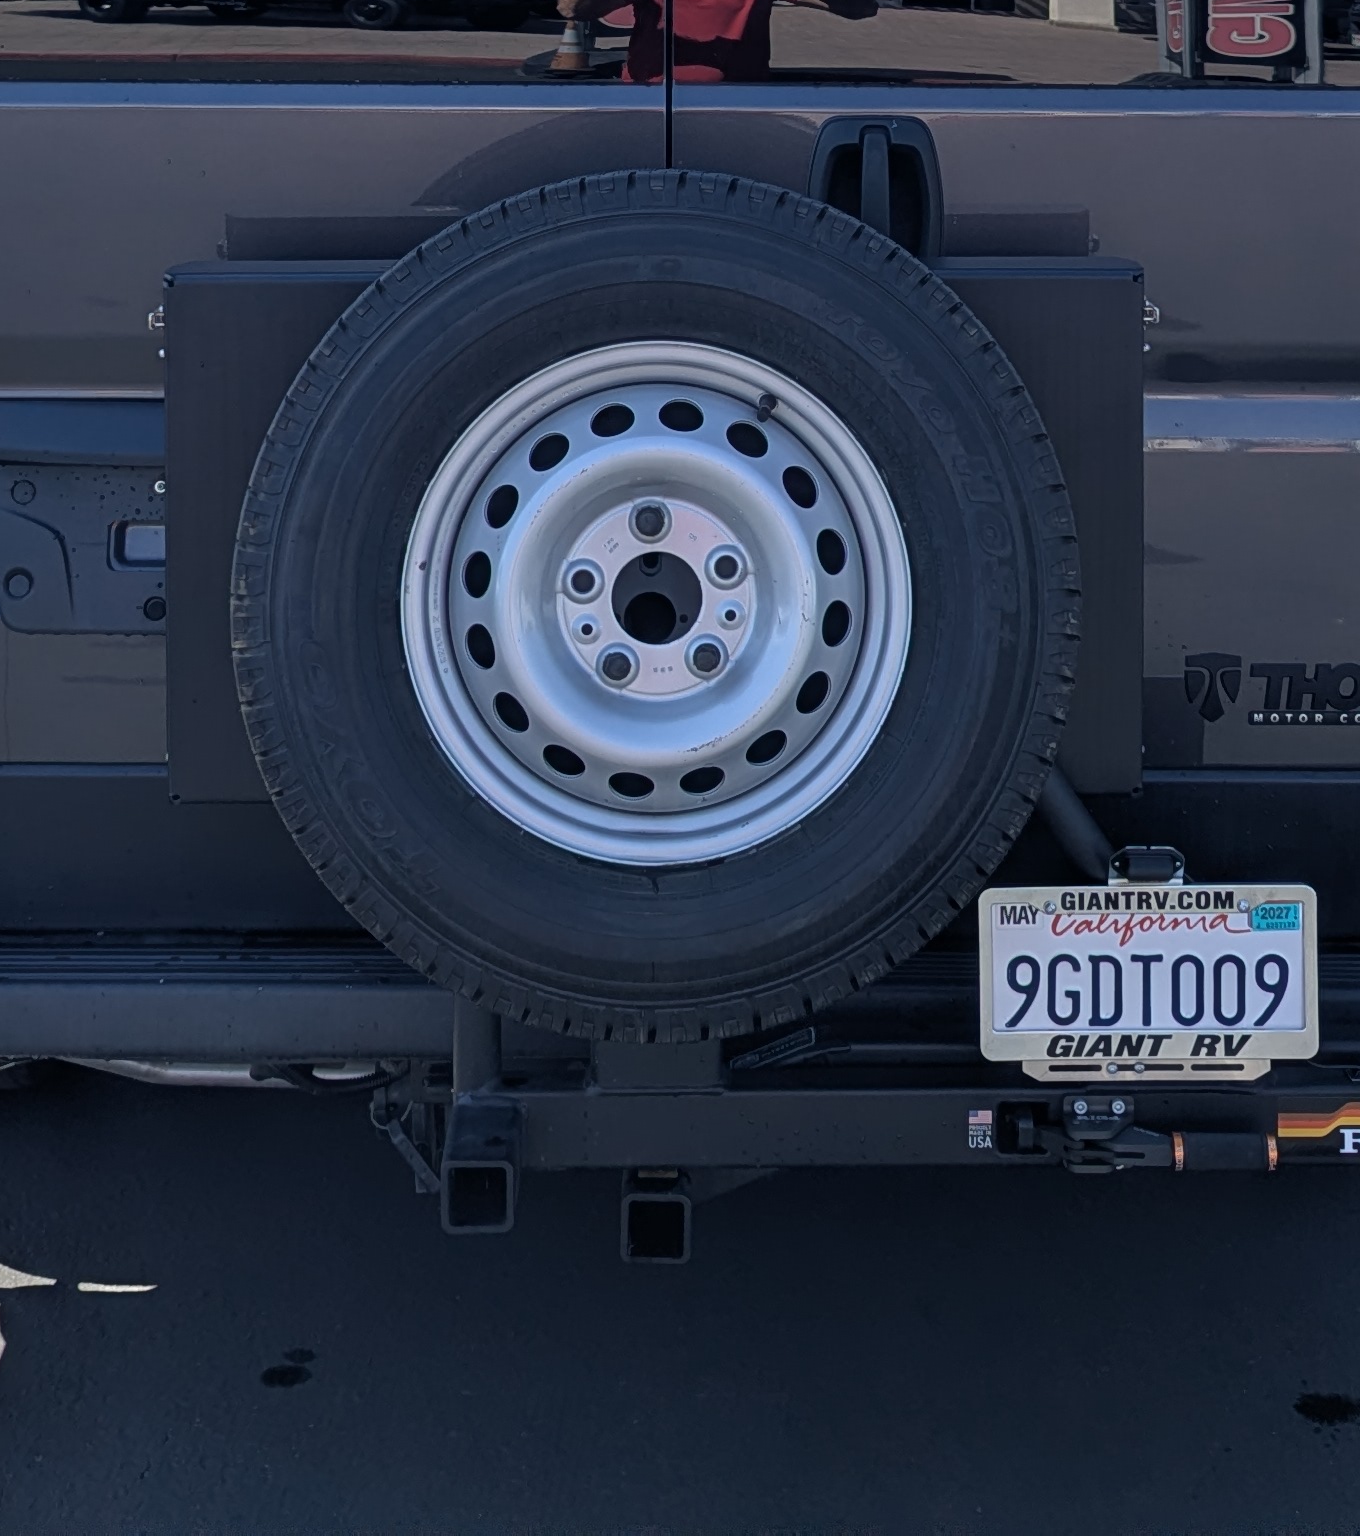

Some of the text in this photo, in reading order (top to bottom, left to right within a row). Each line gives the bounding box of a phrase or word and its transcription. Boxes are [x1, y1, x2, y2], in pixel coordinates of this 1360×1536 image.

[1253, 713, 1324, 724] MOTOR
[1060, 890, 1235, 911] GIANTRV.COM
[999, 905, 1291, 948] MAY California 2027
[1004, 953, 1290, 1028] 9GDT009
[1046, 1034, 1252, 1058] GIANT RV
[968, 1135, 993, 1149] USA
